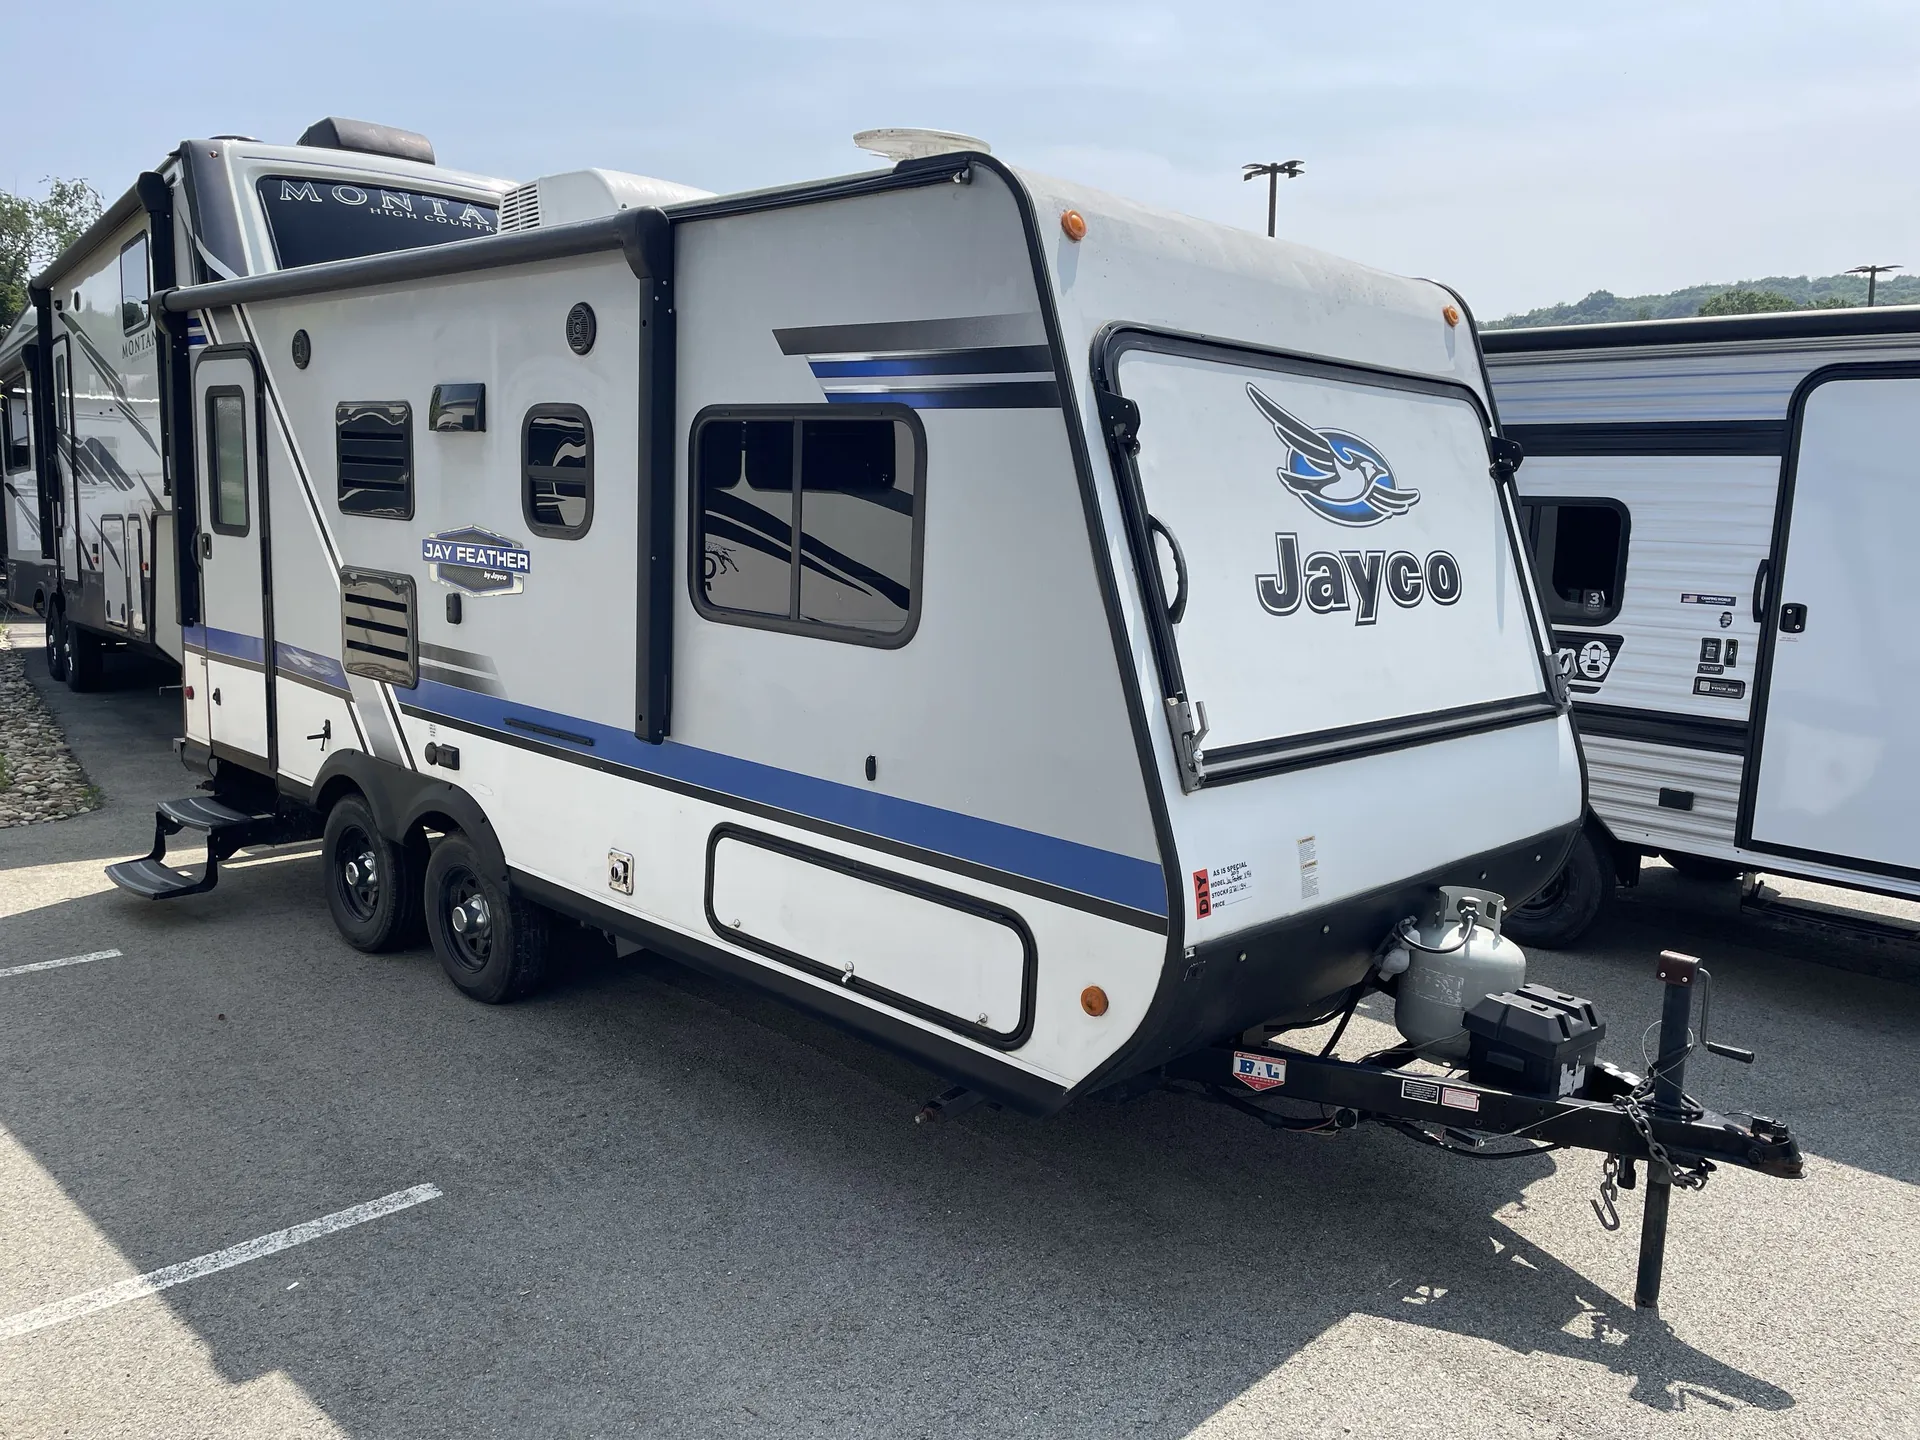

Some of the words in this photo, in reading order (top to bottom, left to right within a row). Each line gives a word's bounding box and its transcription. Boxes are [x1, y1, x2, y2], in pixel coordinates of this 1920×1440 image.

[279, 179, 499, 226] MONTA
[370, 207, 418, 220] HIGH
[423, 543, 453, 561] JAY
[456, 546, 529, 570] FEATHER
[483, 570, 490, 580] by
[490, 571, 507, 581] Jayco
[1254, 531, 1463, 627] Jayco
[1589, 592, 1600, 605] 3
[1213, 869, 1221, 877] AS
[1220, 867, 1227, 875] IS
[1226, 861, 1248, 873] SPECIAL
[1210, 879, 1226, 889] MODEL
[1195, 875, 1209, 916] DIY
[1212, 900, 1226, 909] PRICE
